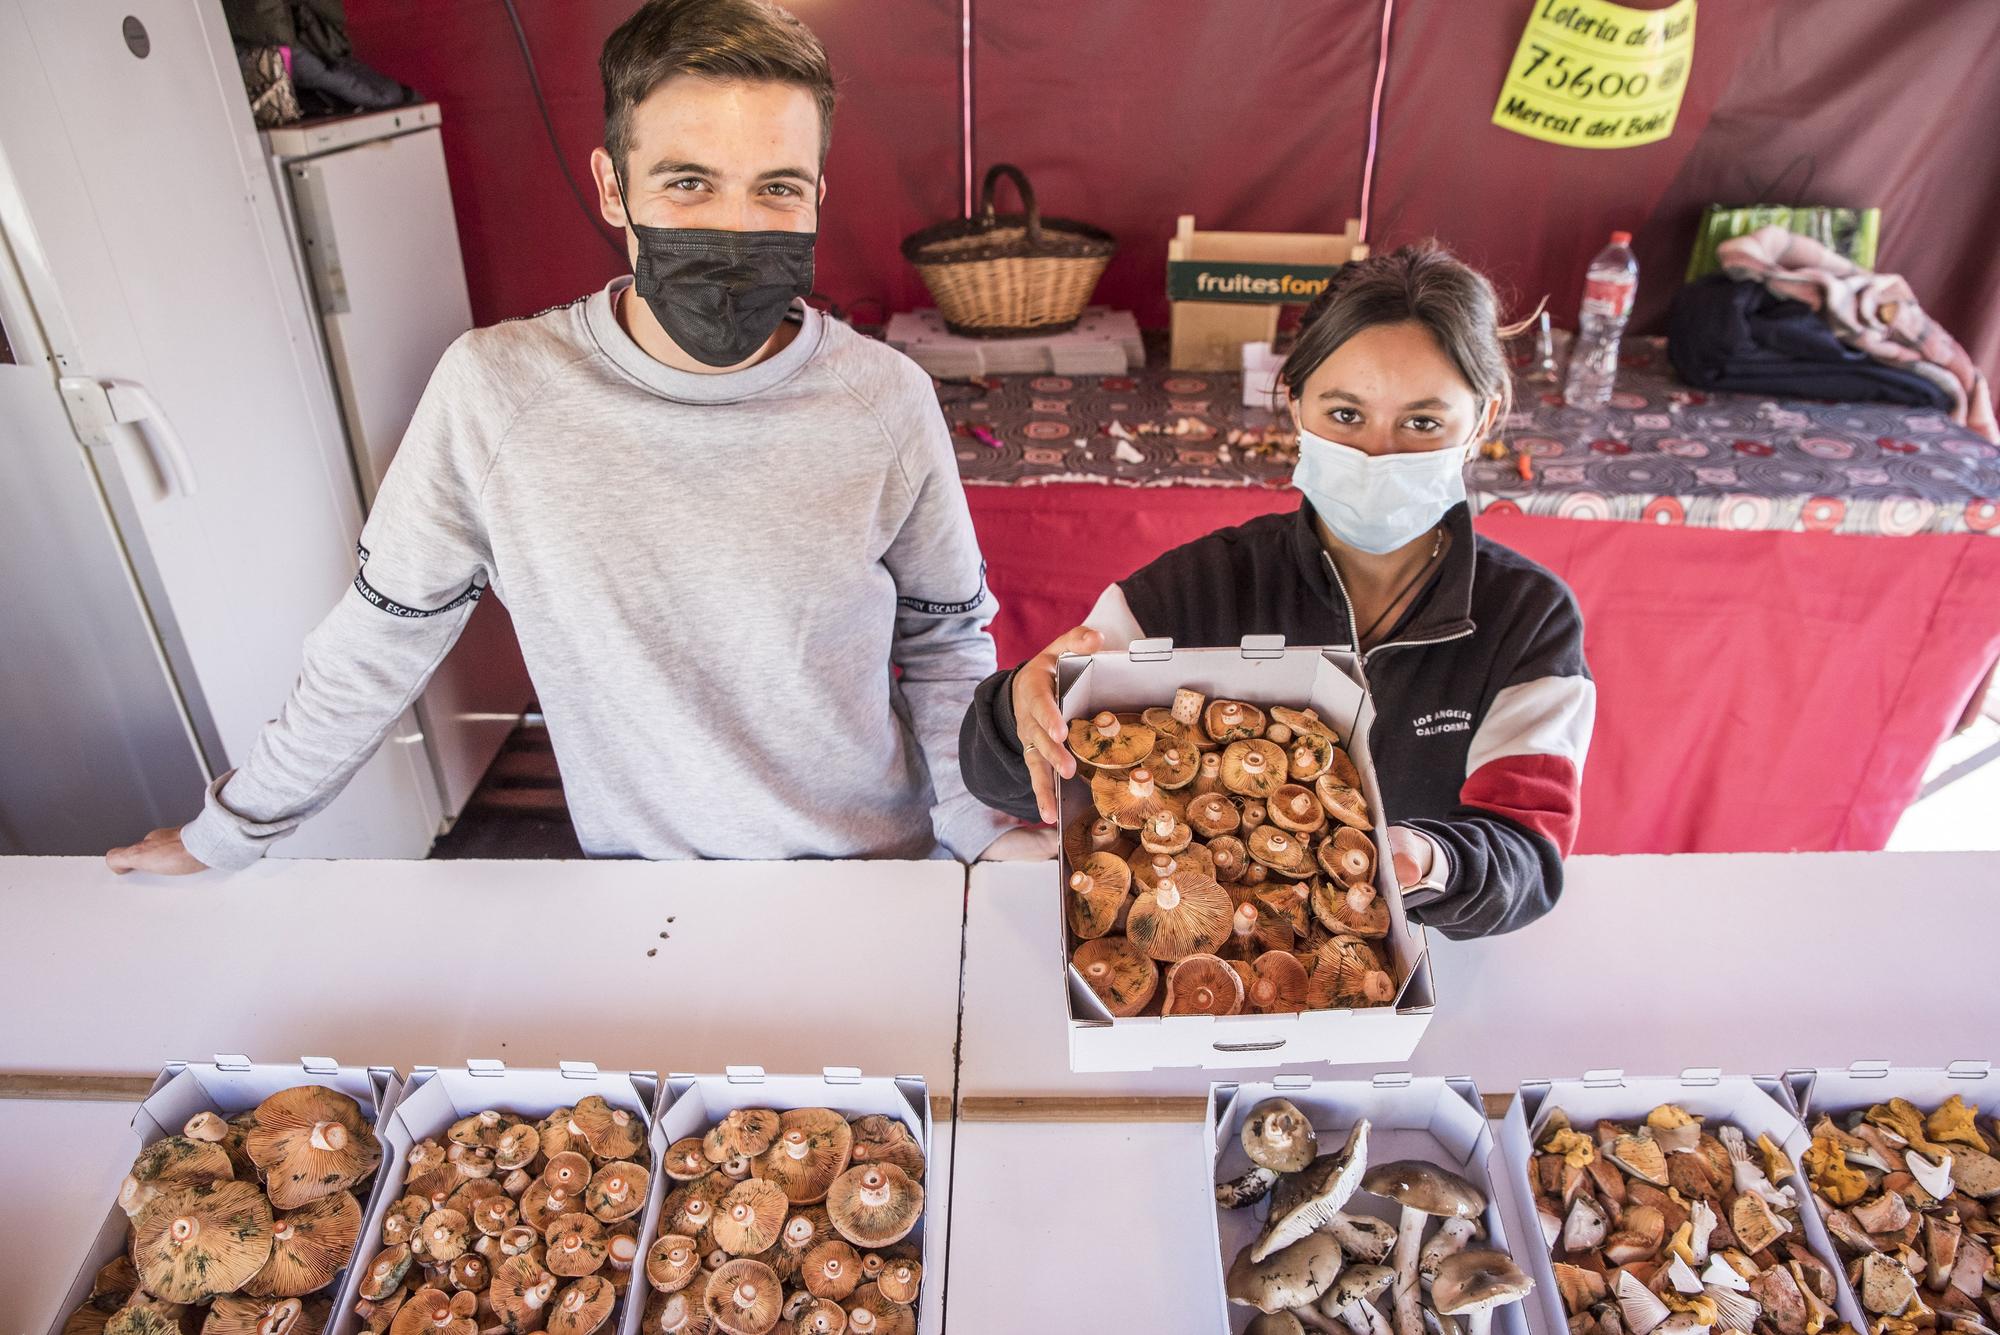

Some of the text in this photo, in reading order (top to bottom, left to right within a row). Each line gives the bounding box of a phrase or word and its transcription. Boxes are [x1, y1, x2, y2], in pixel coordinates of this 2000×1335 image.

[1523, 44, 1649, 99] 75600
[385, 602, 426, 618] ESCAPE
[928, 603, 963, 614] ESCAPE
[1412, 709, 1472, 727] LOS ANGELES
[1415, 721, 1471, 736] CALIFORNIA
